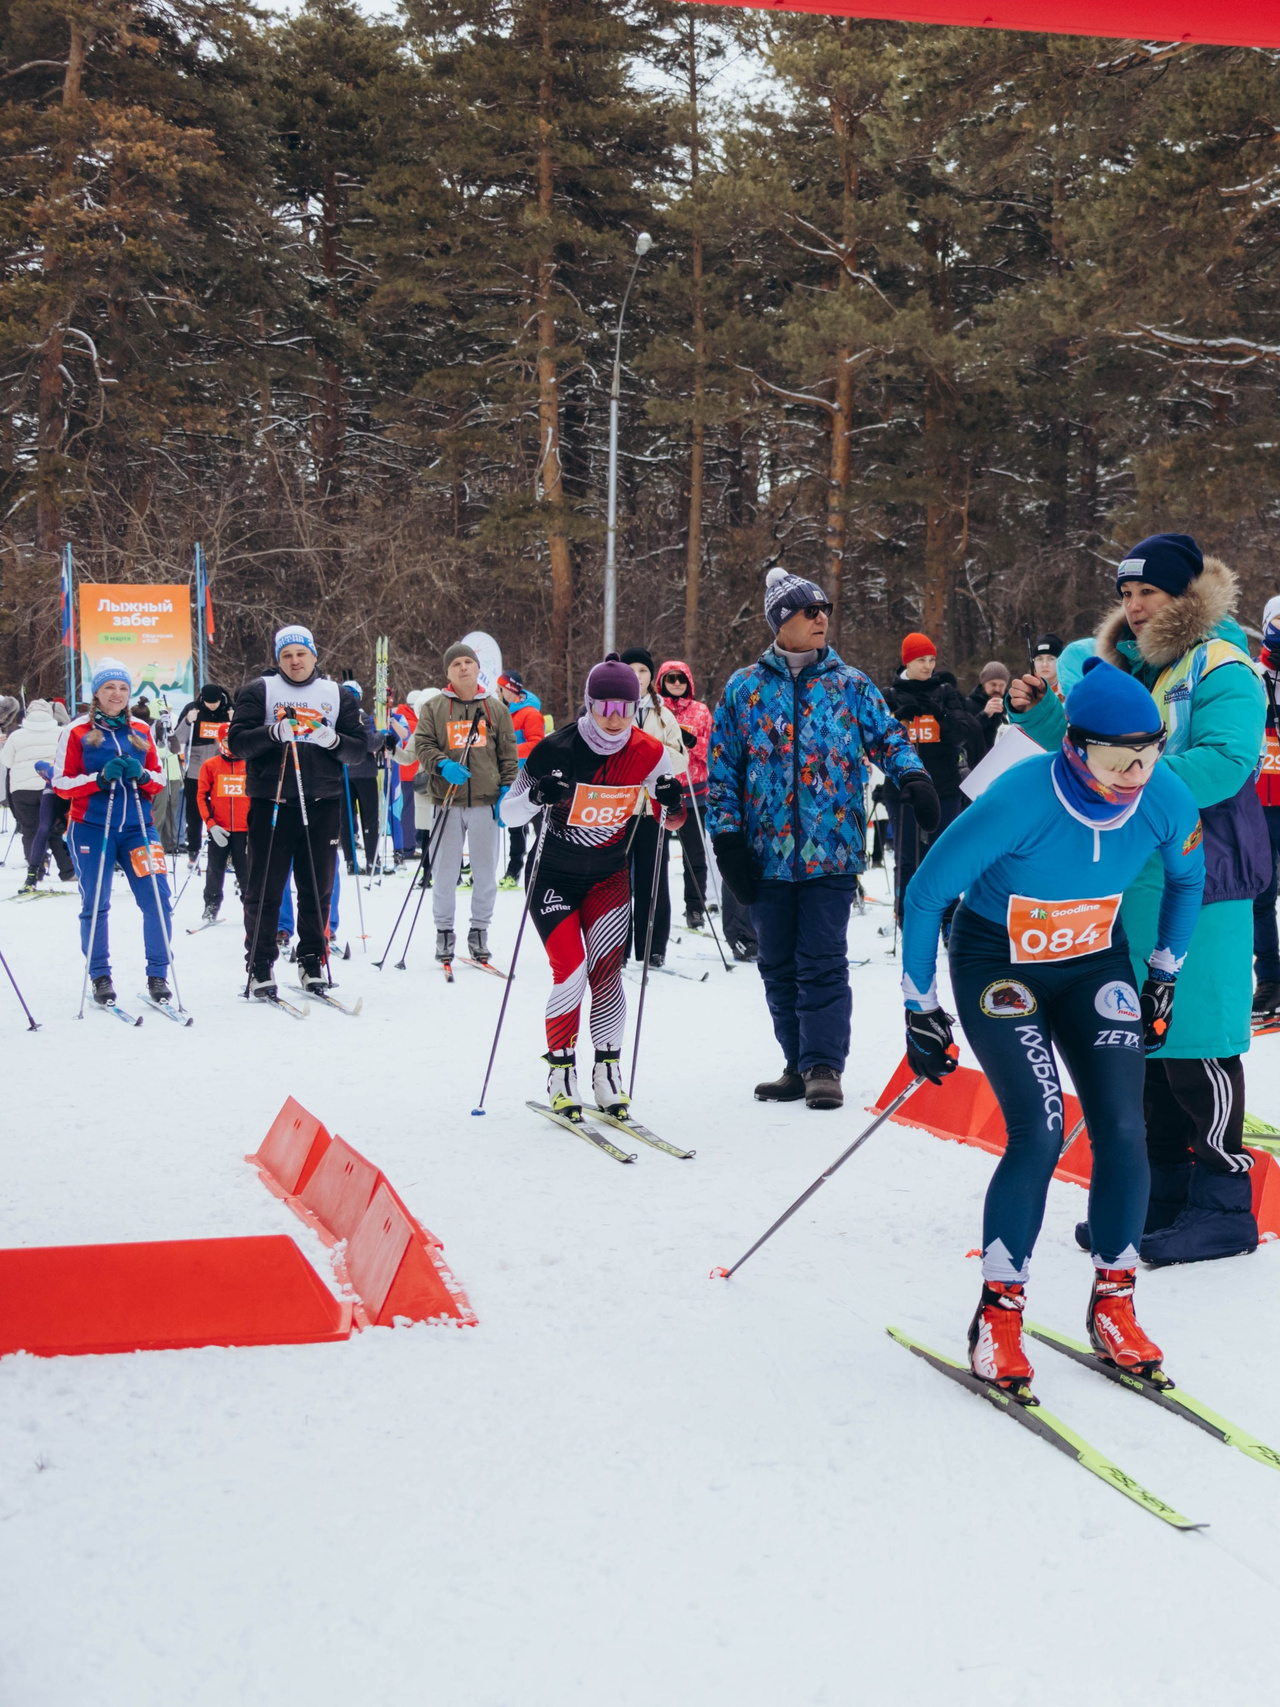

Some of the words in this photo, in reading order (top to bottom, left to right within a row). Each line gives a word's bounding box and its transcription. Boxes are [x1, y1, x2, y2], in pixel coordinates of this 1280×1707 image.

[97, 599, 173, 613] Лыжный
[112, 613, 160, 626] забег
[909, 727, 933, 741] 315
[223, 784, 243, 795] 123
[581, 806, 627, 824] 085
[540, 903, 571, 915] Löffler
[1051, 904, 1100, 918] Goodline
[1021, 922, 1099, 954] 084
[1015, 1025, 1064, 1131] КУЗБАСС
[1098, 1312, 1125, 1345] alpina
[1120, 1374, 1143, 1391] FISCHER
[987, 1388, 1010, 1406] FISCHER
